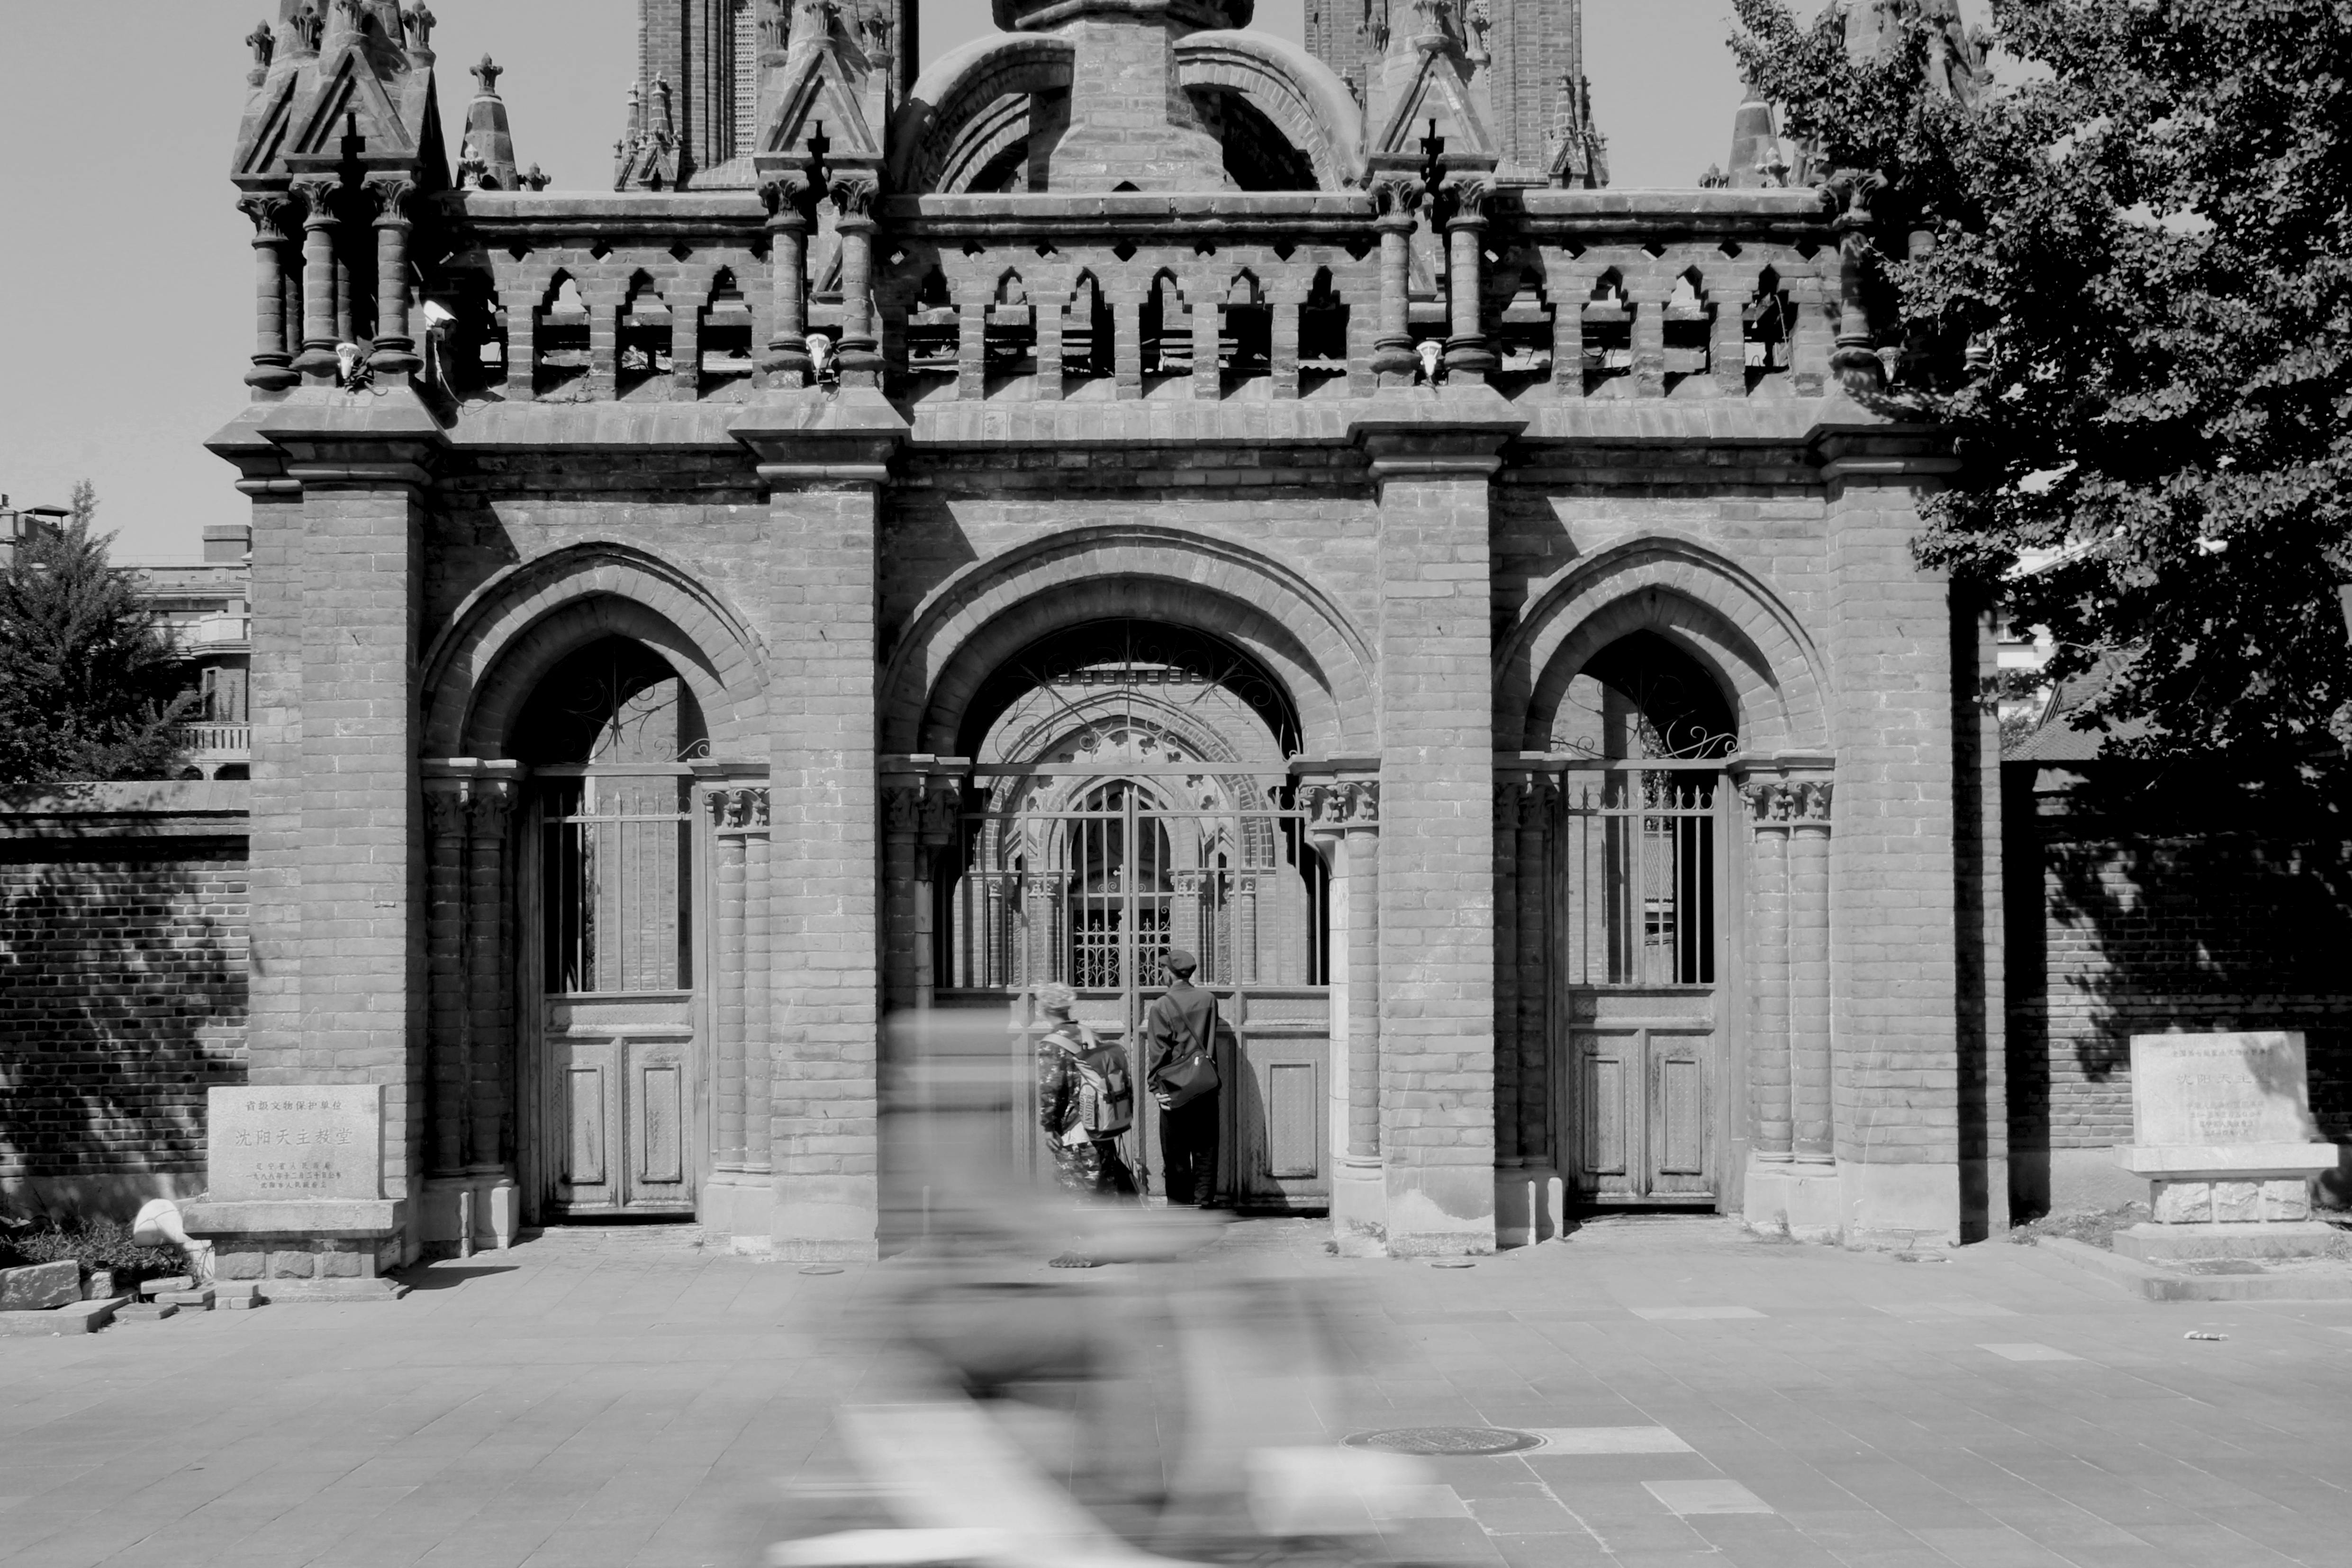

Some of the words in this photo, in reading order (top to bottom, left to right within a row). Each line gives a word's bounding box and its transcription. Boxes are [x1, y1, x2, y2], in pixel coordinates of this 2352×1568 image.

[246, 1101, 341, 1111] 省级文物保护单位
[1085, 1095, 1095, 1125] INSIDER
[236, 1128, 352, 1145] 沈阳天主教堂
